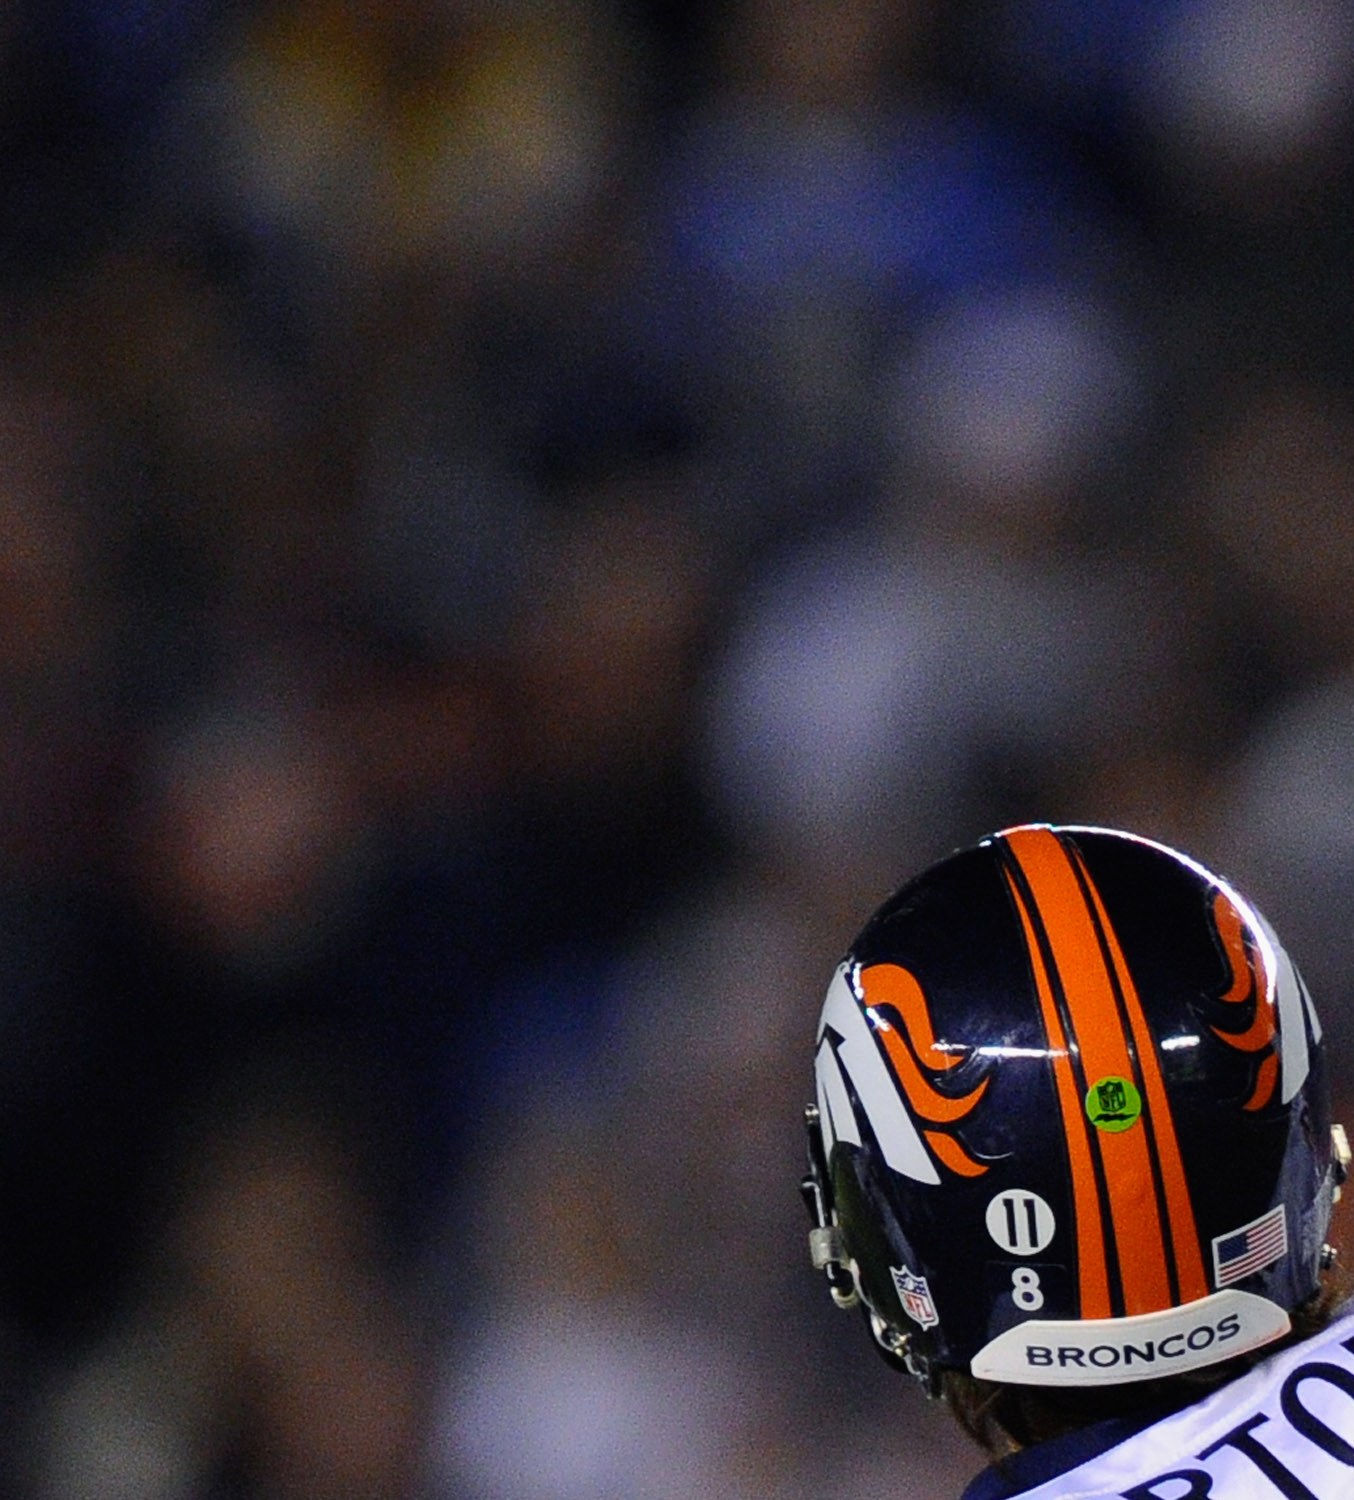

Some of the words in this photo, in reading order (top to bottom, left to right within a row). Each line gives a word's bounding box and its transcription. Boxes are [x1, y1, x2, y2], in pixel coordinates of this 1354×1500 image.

[1003, 1198, 1039, 1248] 11
[1011, 1267, 1044, 1311] 8
[1026, 1314, 1240, 1368] BRONCOS
